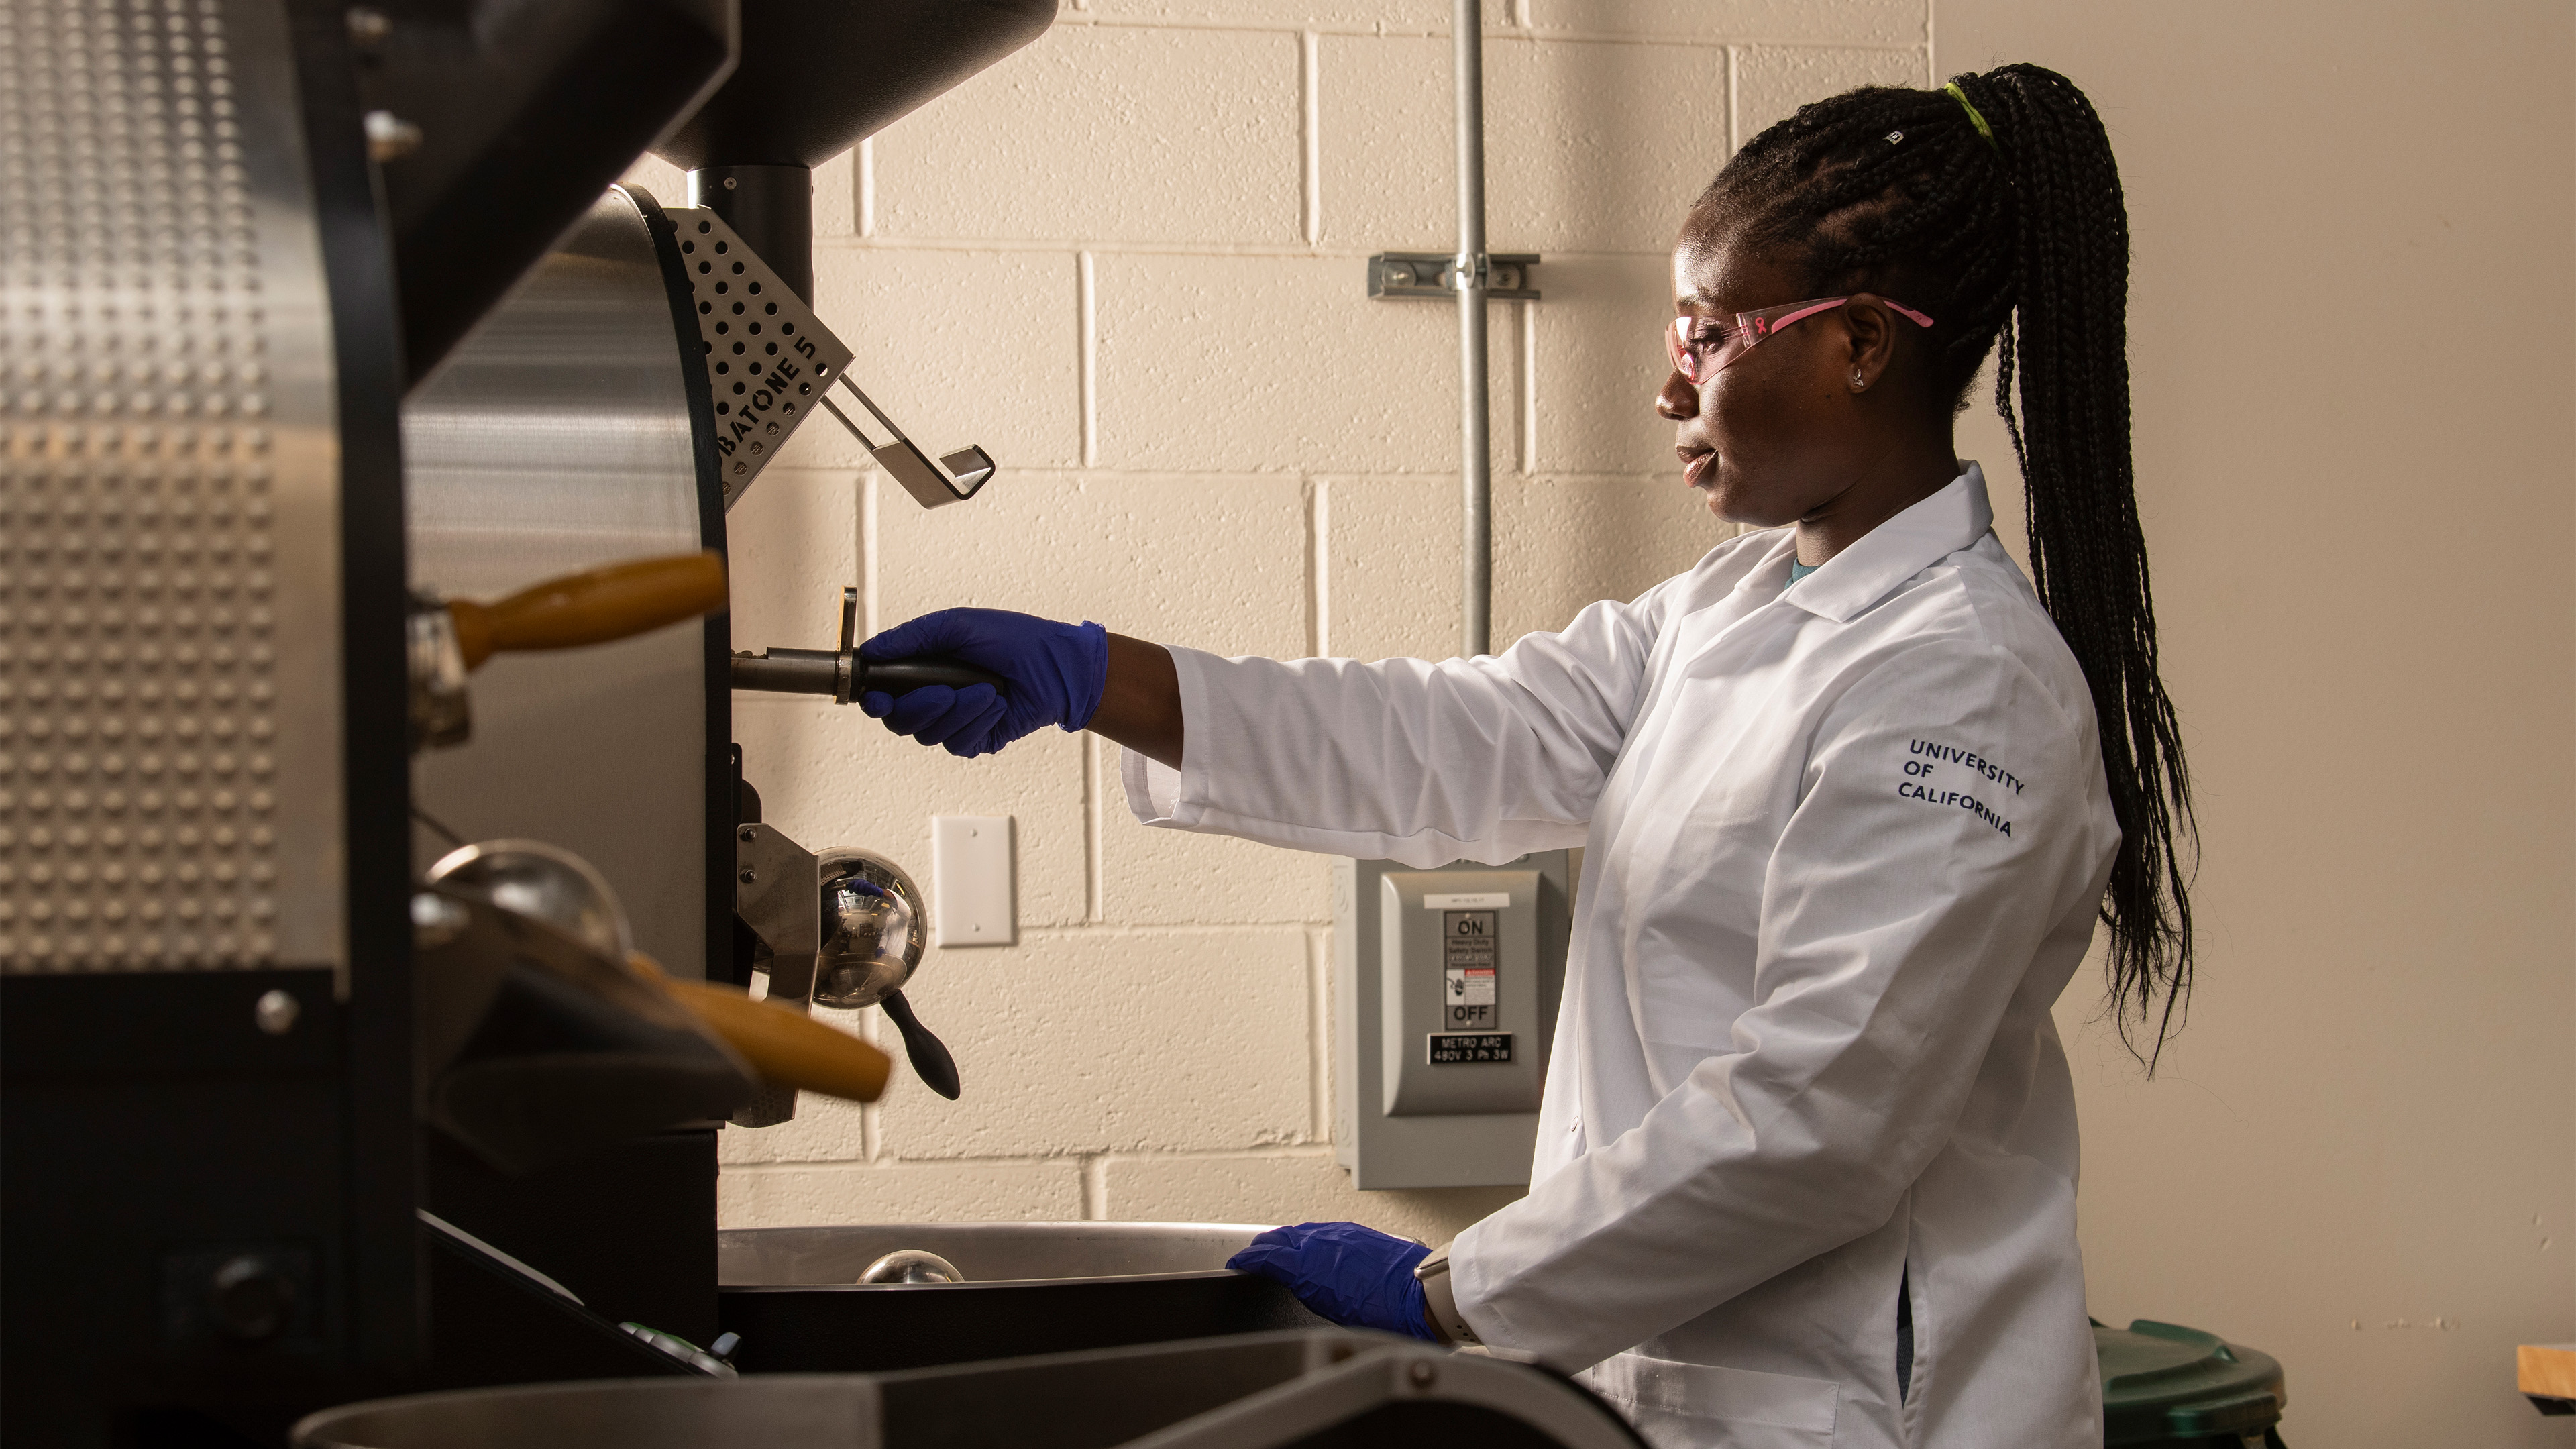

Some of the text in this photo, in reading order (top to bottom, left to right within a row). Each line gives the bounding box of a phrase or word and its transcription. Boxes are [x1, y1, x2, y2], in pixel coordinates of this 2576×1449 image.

[794, 336, 816, 360] 5
[1904, 761, 1933, 777] OF
[1910, 739, 2025, 795] UNIVERSITY
[1898, 782, 2011, 837] CALIFORNIA
[1458, 920, 1483, 934] ON
[1454, 1006, 1487, 1020] OFF
[1442, 1037, 1501, 1049] METRO ARC
[1434, 1051, 1462, 1061] 480V
[1466, 1050, 1473, 1061] 3
[1477, 1050, 1489, 1060] Ph
